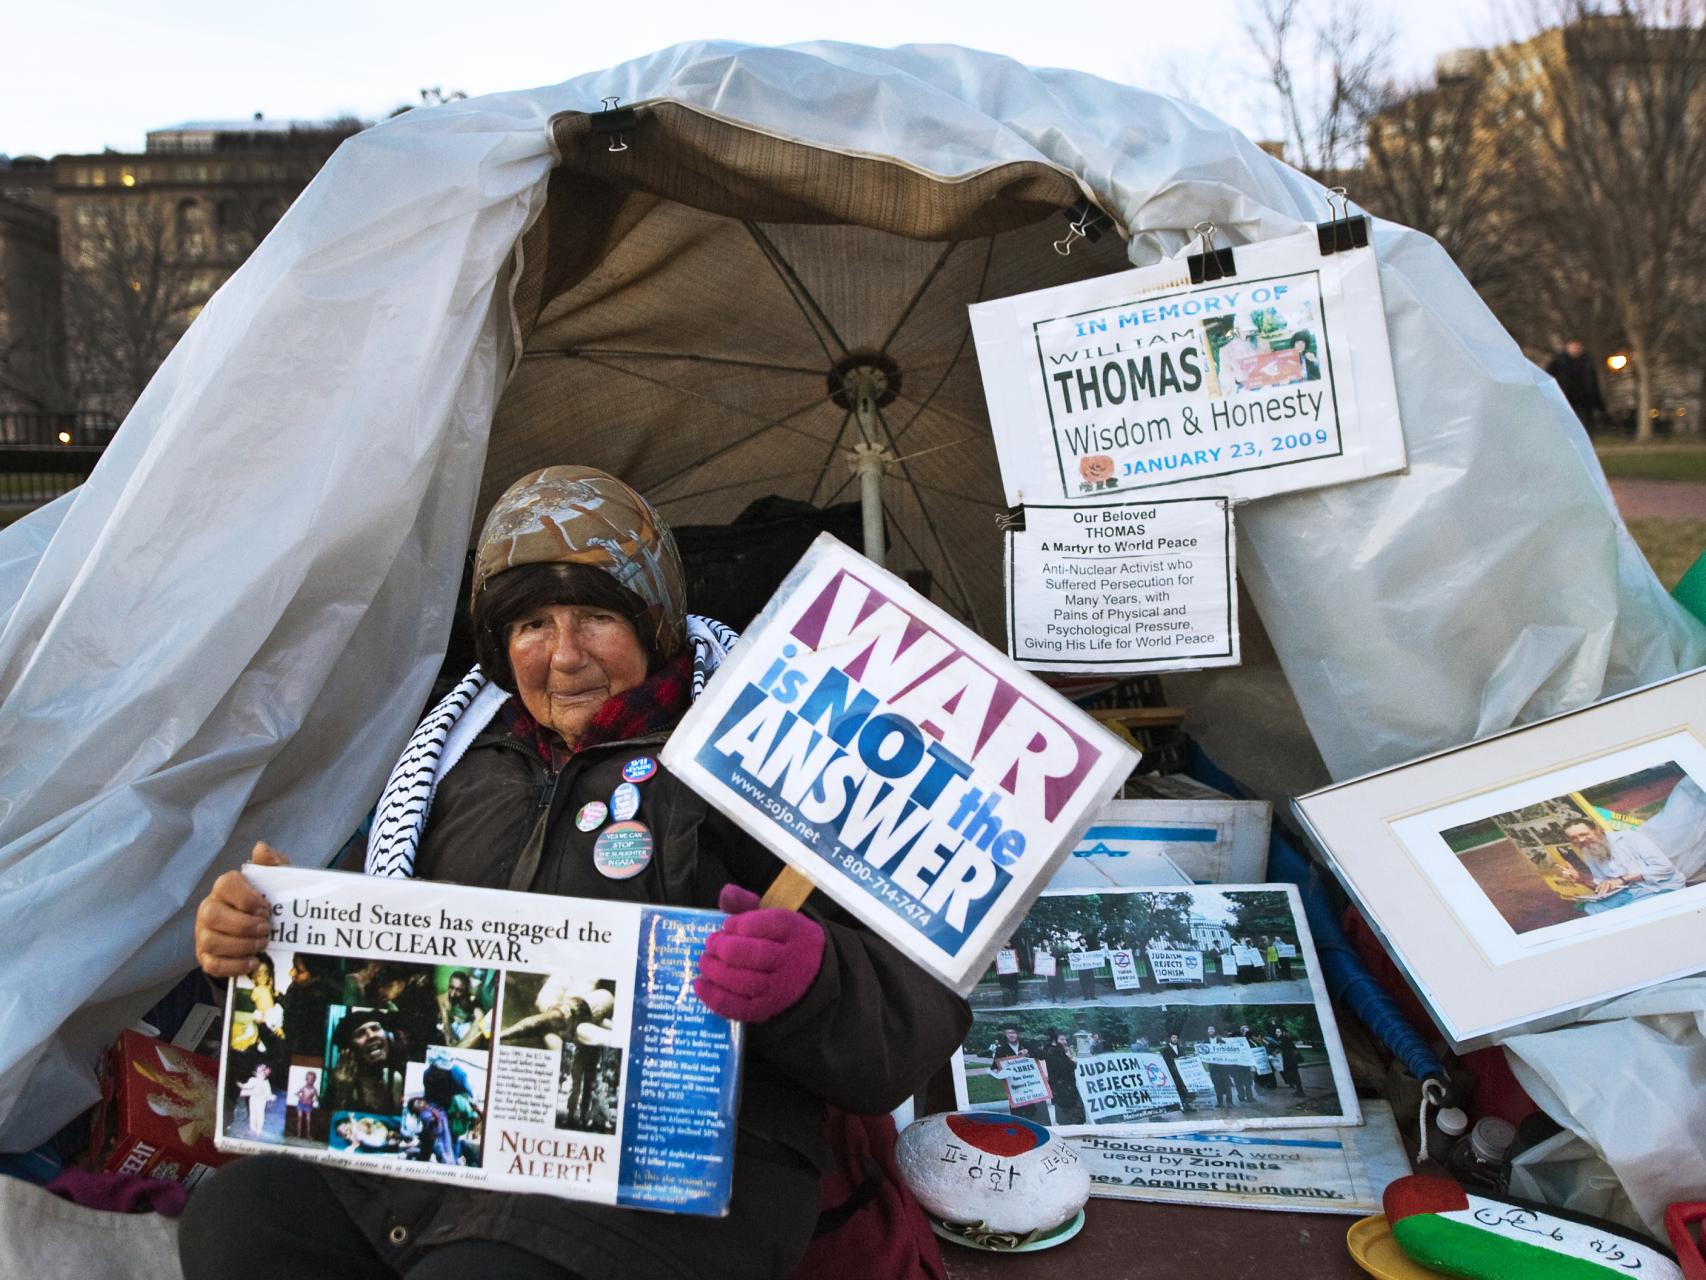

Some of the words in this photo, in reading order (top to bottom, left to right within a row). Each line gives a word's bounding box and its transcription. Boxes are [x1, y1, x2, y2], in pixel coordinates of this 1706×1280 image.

[1075, 321, 1107, 338] IN
[1119, 292, 1240, 329] MEMORY
[1252, 285, 1289, 304] OF
[1049, 328, 1195, 366] WILLIAM
[1053, 346, 1201, 414] THOMAS
[1065, 417, 1172, 457] Wisdom
[1182, 407, 1202, 435] &
[1211, 388, 1323, 432] Honesty
[1123, 447, 1221, 478] JANUARY
[1231, 441, 1263, 459] 23,
[1272, 429, 1327, 452] 2009
[1073, 512, 1097, 524] Our
[1103, 508, 1156, 523] Beloved
[1085, 524, 1146, 538] THOMAS
[1041, 542, 1050, 551] A
[1053, 541, 1093, 555] Martyr
[1098, 542, 1111, 553] to
[1115, 538, 1153, 553] World
[1158, 537, 1198, 549] Peace
[1042, 562, 1117, 575] Anti-Nuclear
[1120, 560, 1164, 574] Activist
[1168, 559, 1193, 571] who
[1045, 577, 1097, 590] Suffered
[1101, 576, 1174, 590] Persecution
[1177, 574, 1194, 585] for
[1065, 594, 1099, 607] Many
[1103, 593, 1142, 606] Years,
[1145, 591, 1170, 602] with
[1054, 609, 1088, 620] Pains
[1092, 608, 1104, 620] of
[1108, 606, 1160, 621] Physical
[1163, 605, 1186, 616] and
[1047, 622, 1132, 638] Psychological
[1135, 620, 1194, 633] Pressure,
[1024, 637, 1063, 652] Giving
[1066, 639, 1085, 650] His
[1089, 637, 1112, 650] Life
[1116, 637, 1132, 648] for
[1135, 634, 1171, 648] World
[808, 571, 1085, 820] WAR
[631, 758, 648, 767] 9/11
[757, 644, 808, 704] is
[797, 666, 975, 811] NOT
[947, 786, 1027, 868] the
[713, 710, 1000, 935] ANSWER
[611, 841, 635, 849] STOP
[730, 771, 823, 846] www.sojo.net
[832, 846, 932, 927] 1-800-714-7474
[292, 899, 362, 924] United
[369, 904, 432, 929] States
[439, 908, 473, 932] has
[481, 918, 569, 945] engaged
[578, 920, 612, 944] the
[269, 921, 299, 944] rld
[306, 925, 326, 946] in
[334, 927, 458, 958] NUCLEAR
[466, 938, 529, 964] WAR.
[1151, 952, 1183, 960] JUDAISM
[1154, 961, 1183, 969] REJECTS
[1079, 1057, 1141, 1077] JUDAISM
[1086, 1073, 1144, 1094] REJECTS
[1087, 1089, 1152, 1113] ZIONISM
[499, 1129, 606, 1163] NUCLEAR
[1228, 1149, 1242, 1158] A
[1250, 1151, 1300, 1161] word
[506, 1154, 593, 1183] ALERT!
[1103, 1150, 1152, 1163] used
[1160, 1154, 1183, 1167] by
[1189, 1156, 1282, 1171] Zionists
[405, 1166, 458, 1179] mushroom
[1124, 1164, 1143, 1175] to
[1150, 1167, 1258, 1182] perpetrate
[1129, 1175, 1218, 1192] Against
[1225, 1181, 1345, 1199] Humanity.
